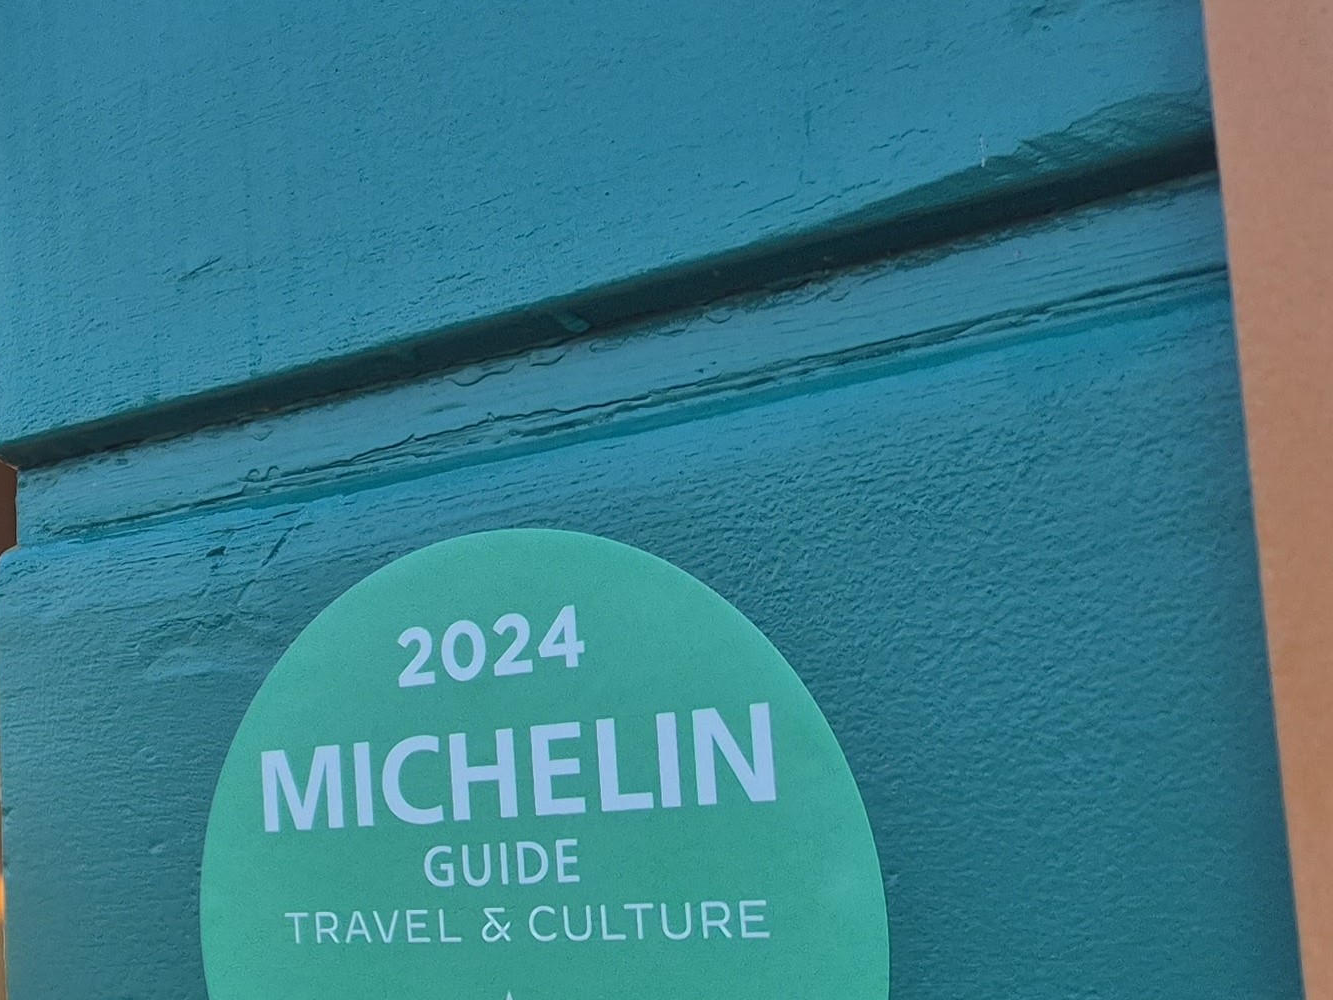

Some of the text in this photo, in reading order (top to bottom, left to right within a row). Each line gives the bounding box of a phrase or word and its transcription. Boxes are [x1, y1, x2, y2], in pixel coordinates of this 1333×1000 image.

[398, 605, 584, 687] 2024
[261, 702, 777, 832] MICHELIN
[423, 838, 580, 887] GUIDE
[284, 901, 770, 944] TRAVEL & CULTURE
